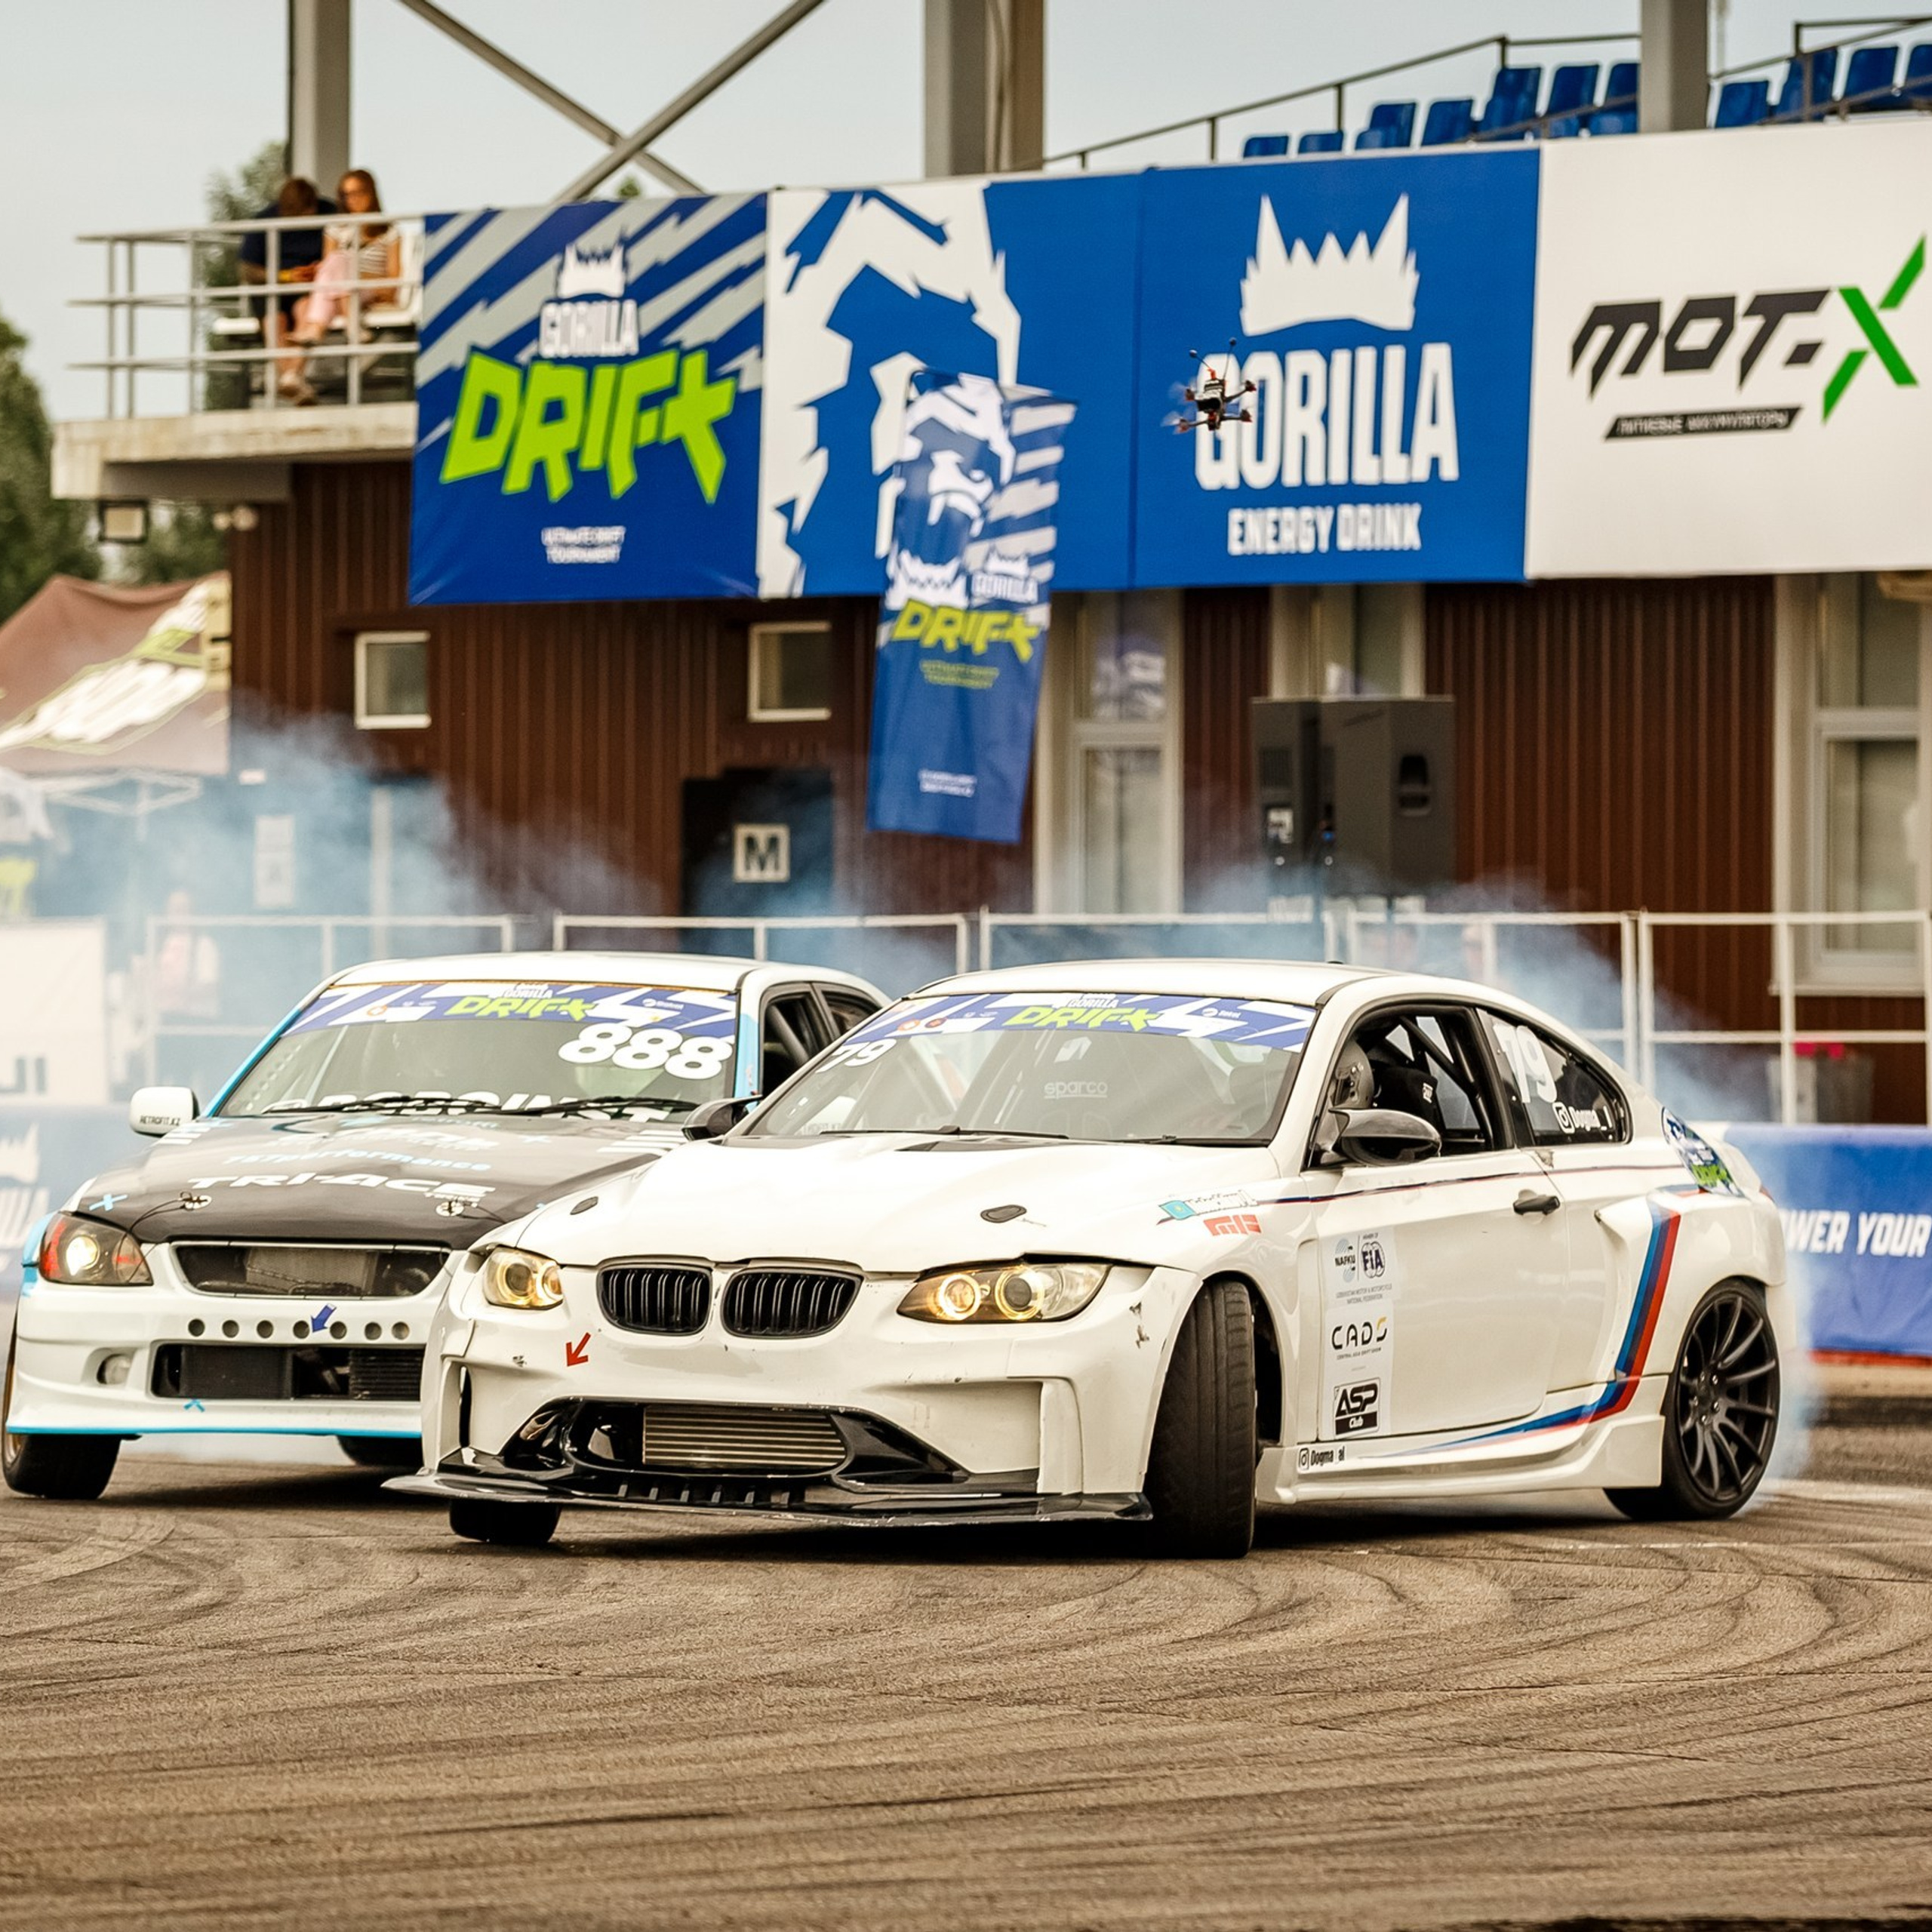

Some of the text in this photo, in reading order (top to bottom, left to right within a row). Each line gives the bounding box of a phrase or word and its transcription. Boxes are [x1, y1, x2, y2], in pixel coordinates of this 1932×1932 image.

[540, 299, 640, 358] GORILLA
[1195, 342, 1460, 491] GORILLA
[1227, 502, 1423, 556] ENERGY DRINK
[1068, 998, 1120, 1009] GORILLA
[558, 1023, 733, 1080] 888
[1044, 1081, 1108, 1100] sparco
[186, 1171, 497, 1198] TRI-ACE
[1856, 1211, 1932, 1258] YOUR
[1335, 1383, 1379, 1418] ASP
